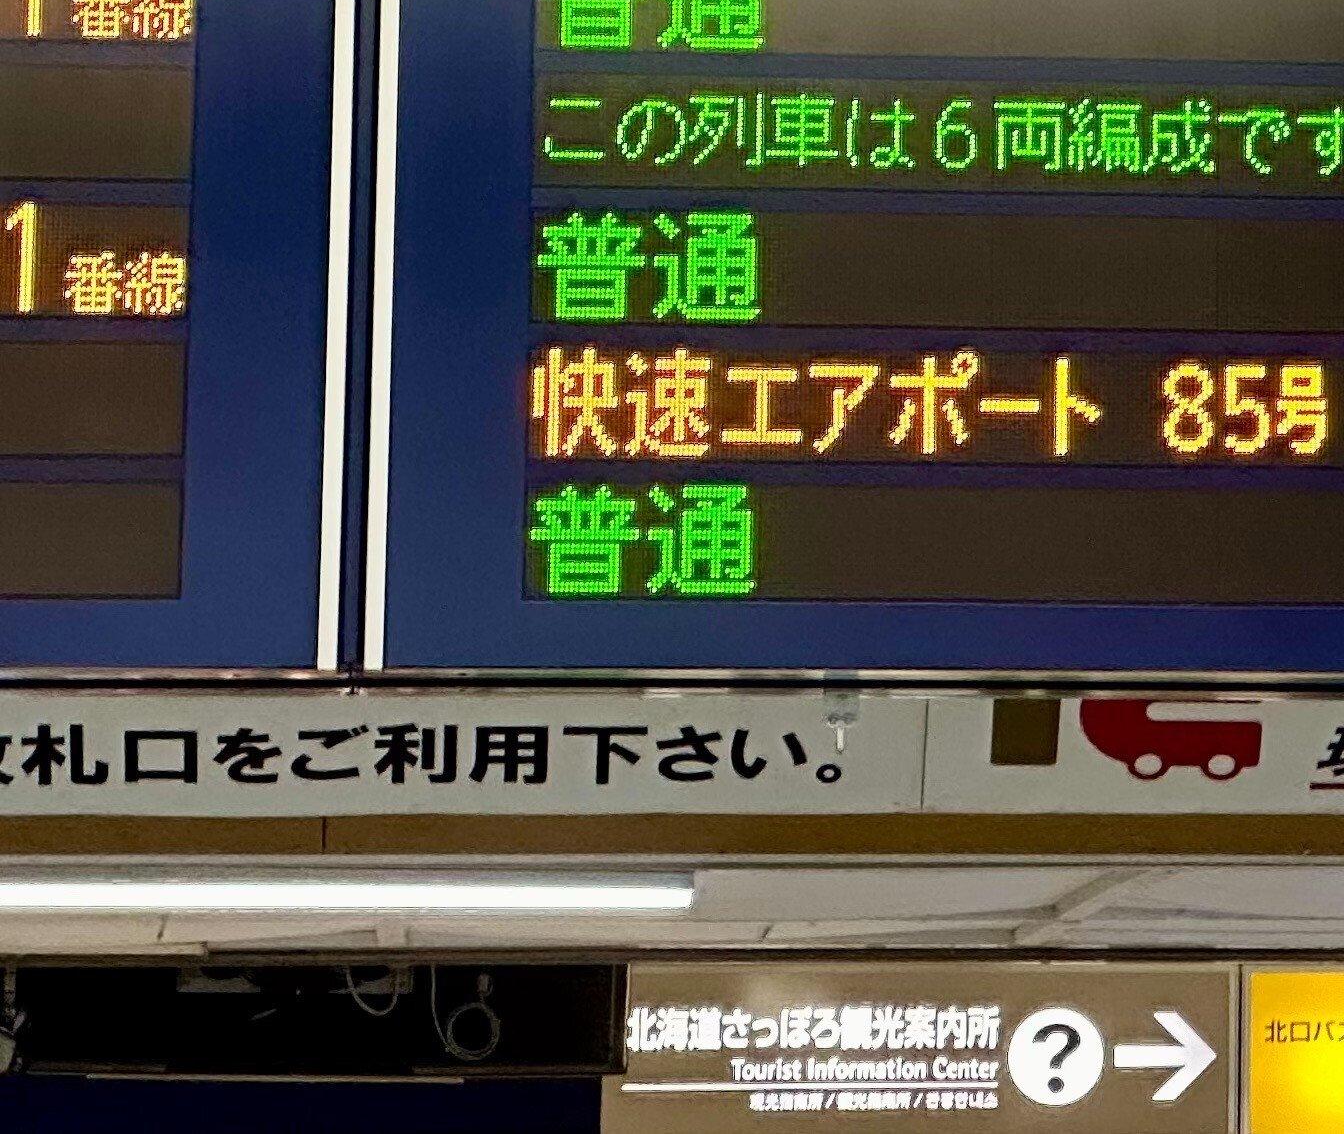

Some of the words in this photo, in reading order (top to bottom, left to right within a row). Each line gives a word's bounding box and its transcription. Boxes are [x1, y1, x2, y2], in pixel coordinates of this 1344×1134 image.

[537, 213, 760, 320] 普通
[531, 346, 1104, 456] 快速エアポート
[1162, 363, 1328, 454] 85号
[530, 485, 754, 593] 普通
[0, 723, 844, 785] 札口をご利用下さい。
[731, 1057, 802, 1082] Tourist
[806, 1056, 928, 1081] Information
